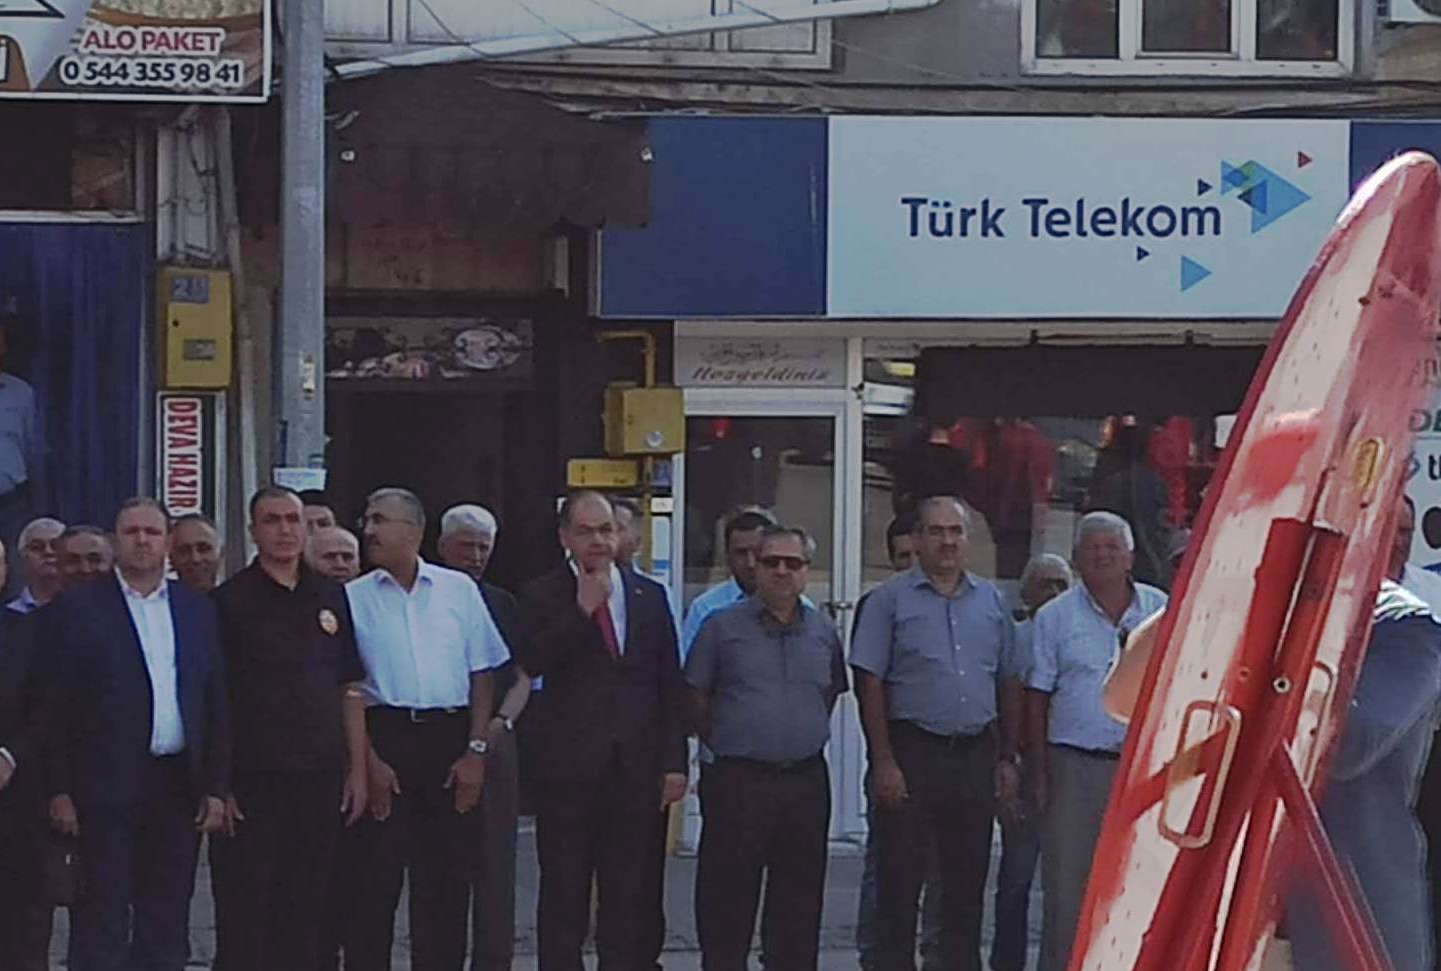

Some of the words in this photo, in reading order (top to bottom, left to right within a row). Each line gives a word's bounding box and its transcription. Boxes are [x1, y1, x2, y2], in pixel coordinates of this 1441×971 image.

[83, 30, 137, 50] ALO
[141, 31, 222, 51] PAKET
[64, 60, 80, 80] 0
[84, 62, 130, 81] 544
[134, 63, 176, 82] 355
[180, 63, 211, 82] 98
[215, 64, 240, 82] 41
[901, 197, 1007, 238] Türk
[1021, 197, 1222, 238] Telekom
[167, 401, 198, 449] DEVA
